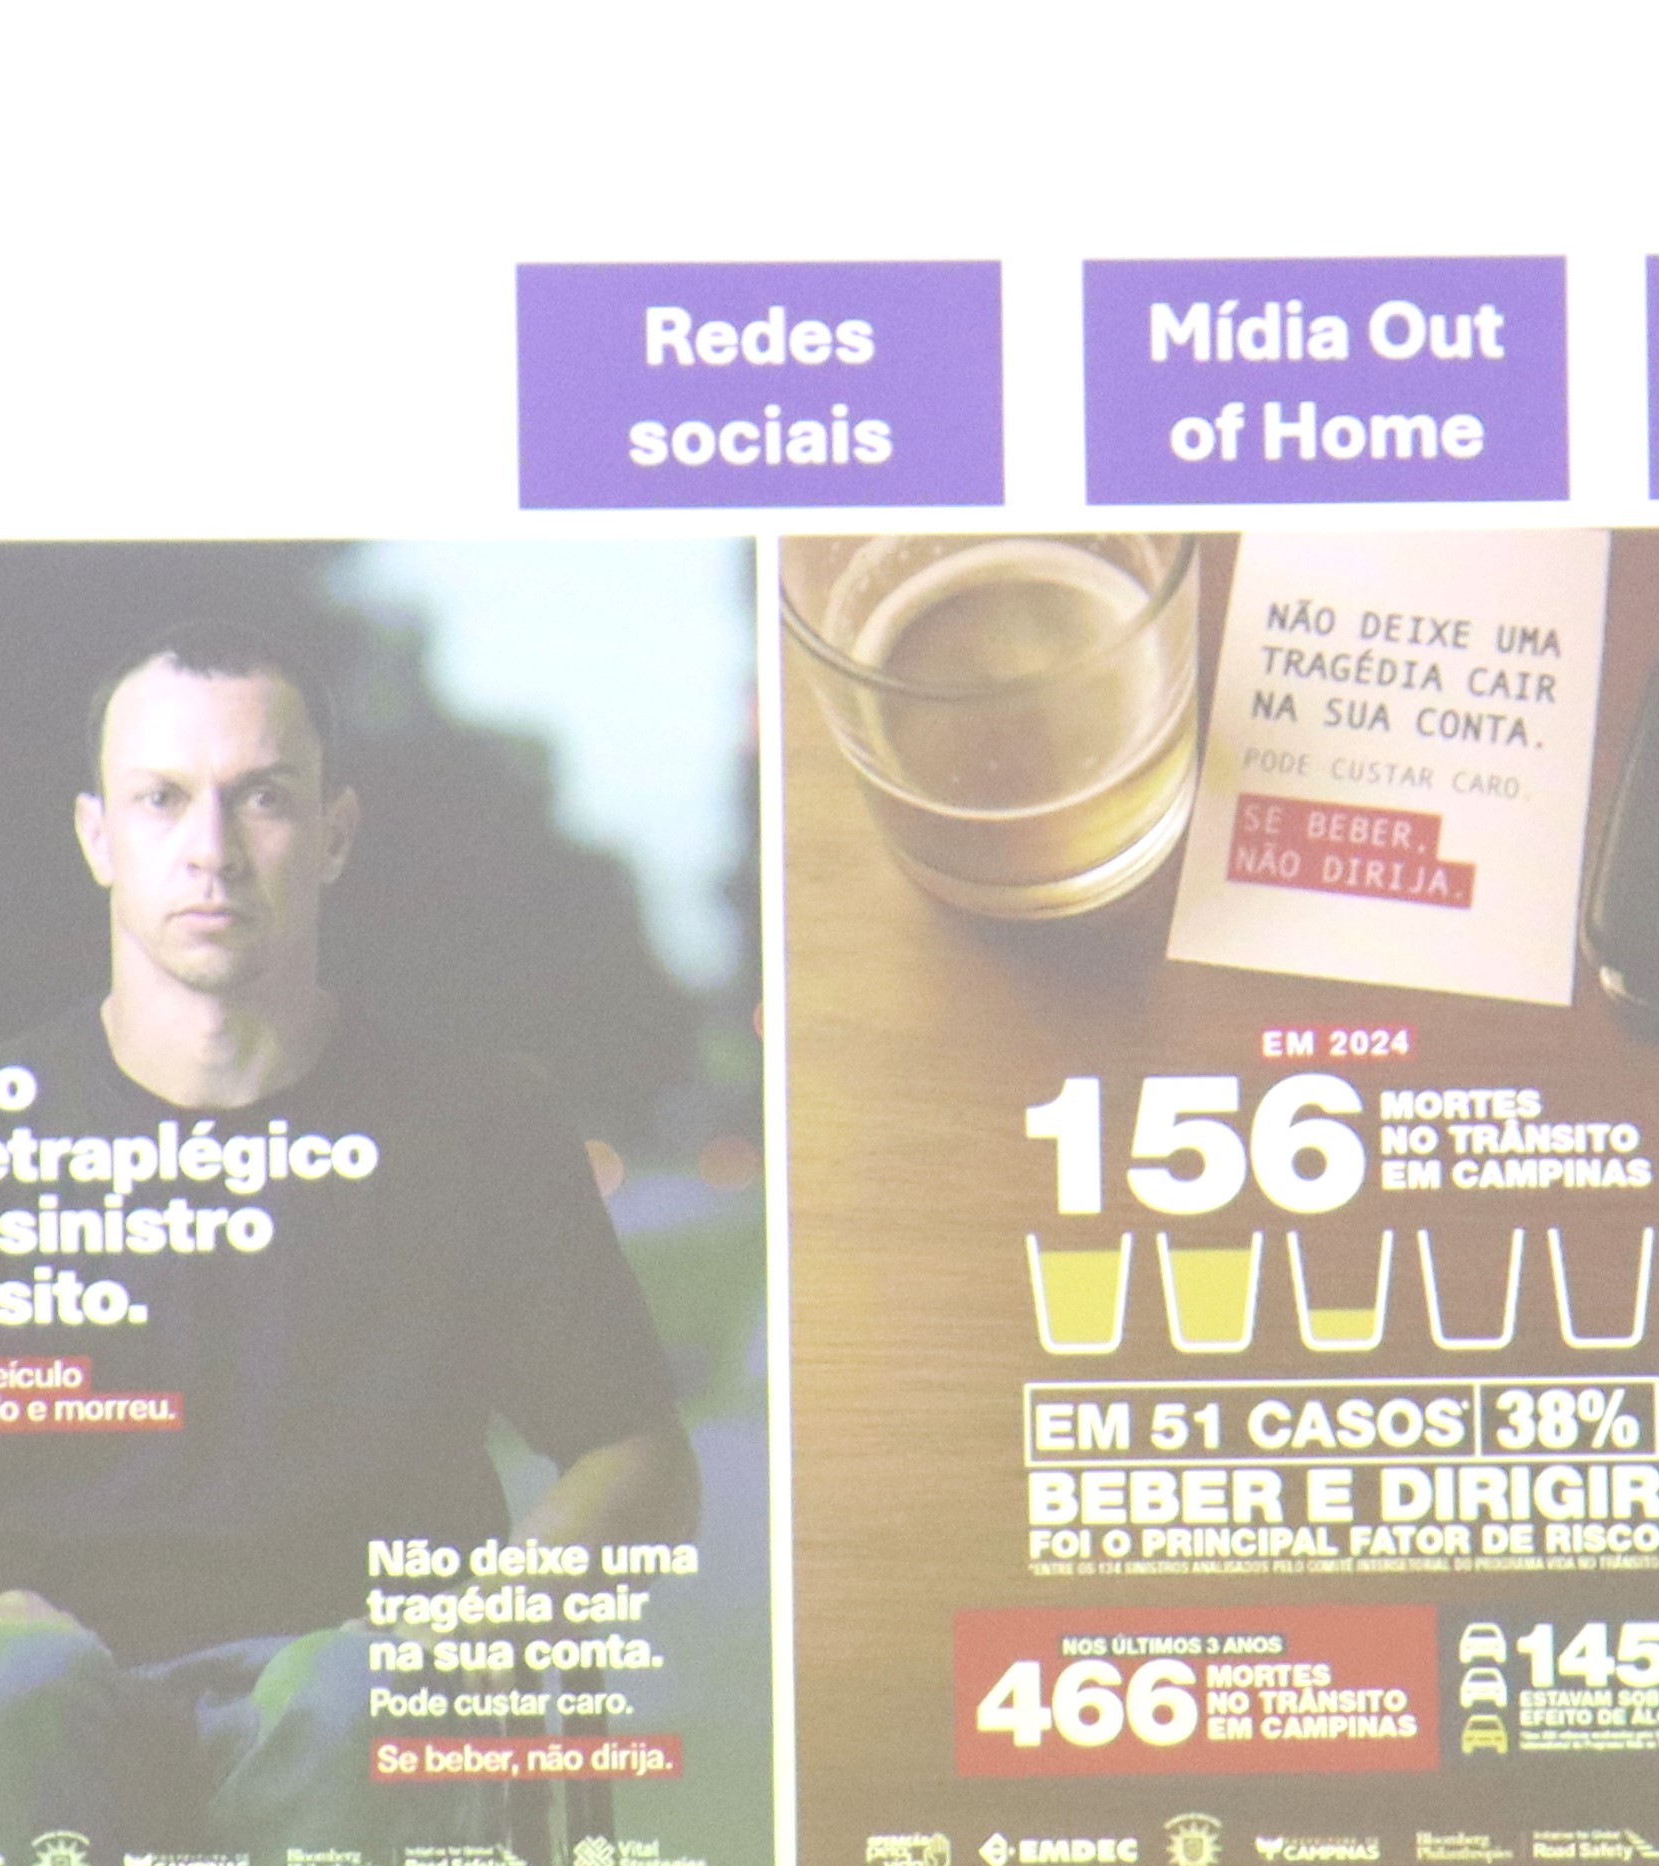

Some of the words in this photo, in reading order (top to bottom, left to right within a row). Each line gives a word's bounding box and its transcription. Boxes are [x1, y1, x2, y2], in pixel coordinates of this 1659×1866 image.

[644, 305, 875, 366] Redes
[1148, 301, 1350, 362] Mídia
[1368, 299, 1505, 360] Out
[628, 404, 894, 467] sociais
[1168, 402, 1243, 460] of
[1262, 401, 1485, 459] Home
[1265, 598, 1337, 638] NÃO
[1360, 610, 1472, 650] DEIXE
[1495, 624, 1563, 659] UMA
[1261, 645, 1443, 693] TRAGÉDIA
[1467, 666, 1557, 704] CAIR
[1251, 690, 1298, 723] NA
[1322, 697, 1391, 732] SUA
[1415, 707, 1544, 750] CONTA.
[1243, 747, 1312, 777] PODE
[1330, 757, 1435, 791] CUSTAR
[1243, 803, 1283, 836] SE
[1233, 841, 1302, 880] NÃO
[1262, 1031, 1316, 1058] EM
[1329, 1030, 1411, 1056] 2024
[1380, 1088, 1542, 1121] MORTES
[1025, 1072, 1367, 1216] 156
[1380, 1126, 1438, 1156] NO
[1447, 1117, 1641, 1154] TRÂNSITO
[1381, 1160, 1441, 1191] EM
[1451, 1157, 1653, 1190] CAMPINAS
[27, 1399, 47, 1423] e
[54, 1398, 176, 1423] morreu.
[1035, 1402, 1132, 1450] EM
[1150, 1401, 1222, 1450] 51
[1494, 1388, 1641, 1452] 38%
[1027, 1470, 1285, 1525] BEBER
[1305, 1467, 1354, 1522] E
[367, 1540, 460, 1577] Não
[469, 1538, 590, 1576] deixe
[601, 1543, 699, 1575] uma
[1028, 1529, 1092, 1559] FOI
[1102, 1529, 1133, 1559] O
[1141, 1526, 1339, 1558] PRINCIPAL
[1349, 1524, 1472, 1556] FATOR
[1481, 1523, 1534, 1554] DE
[366, 1585, 553, 1633] tragédia
[563, 1584, 650, 1622] cair
[368, 1639, 424, 1672] na
[434, 1638, 515, 1671] sua
[524, 1633, 664, 1669] conta.
[1062, 1638, 1108, 1656] NOS
[1111, 1633, 1203, 1656] ÚLTIMOS
[1205, 1637, 1221, 1655] 3
[1223, 1636, 1283, 1654] ANOS
[1206, 1663, 1332, 1689] MORTES
[369, 1687, 448, 1718] Pode
[453, 1688, 550, 1717] custar
[557, 1692, 634, 1717] caro.
[976, 1658, 1199, 1747] 466
[1206, 1690, 1250, 1715] NO
[1258, 1686, 1408, 1714] TRÂNSITO
[1519, 1688, 1613, 1709] ESTAVAM
[1519, 1707, 1593, 1728] EFEITO
[1597, 1707, 1628, 1727] DE
[1206, 1716, 1253, 1741] EM
[1260, 1714, 1419, 1740] CAMPINAS
[376, 1744, 419, 1774] Se
[424, 1744, 520, 1777] beber,
[527, 1743, 584, 1772] não
[591, 1742, 674, 1777] dirija.
[618, 1839, 660, 1858] Vital
[1019, 1836, 1139, 1865] EMDEC
[1282, 1843, 1381, 1862] CAMPINAS
